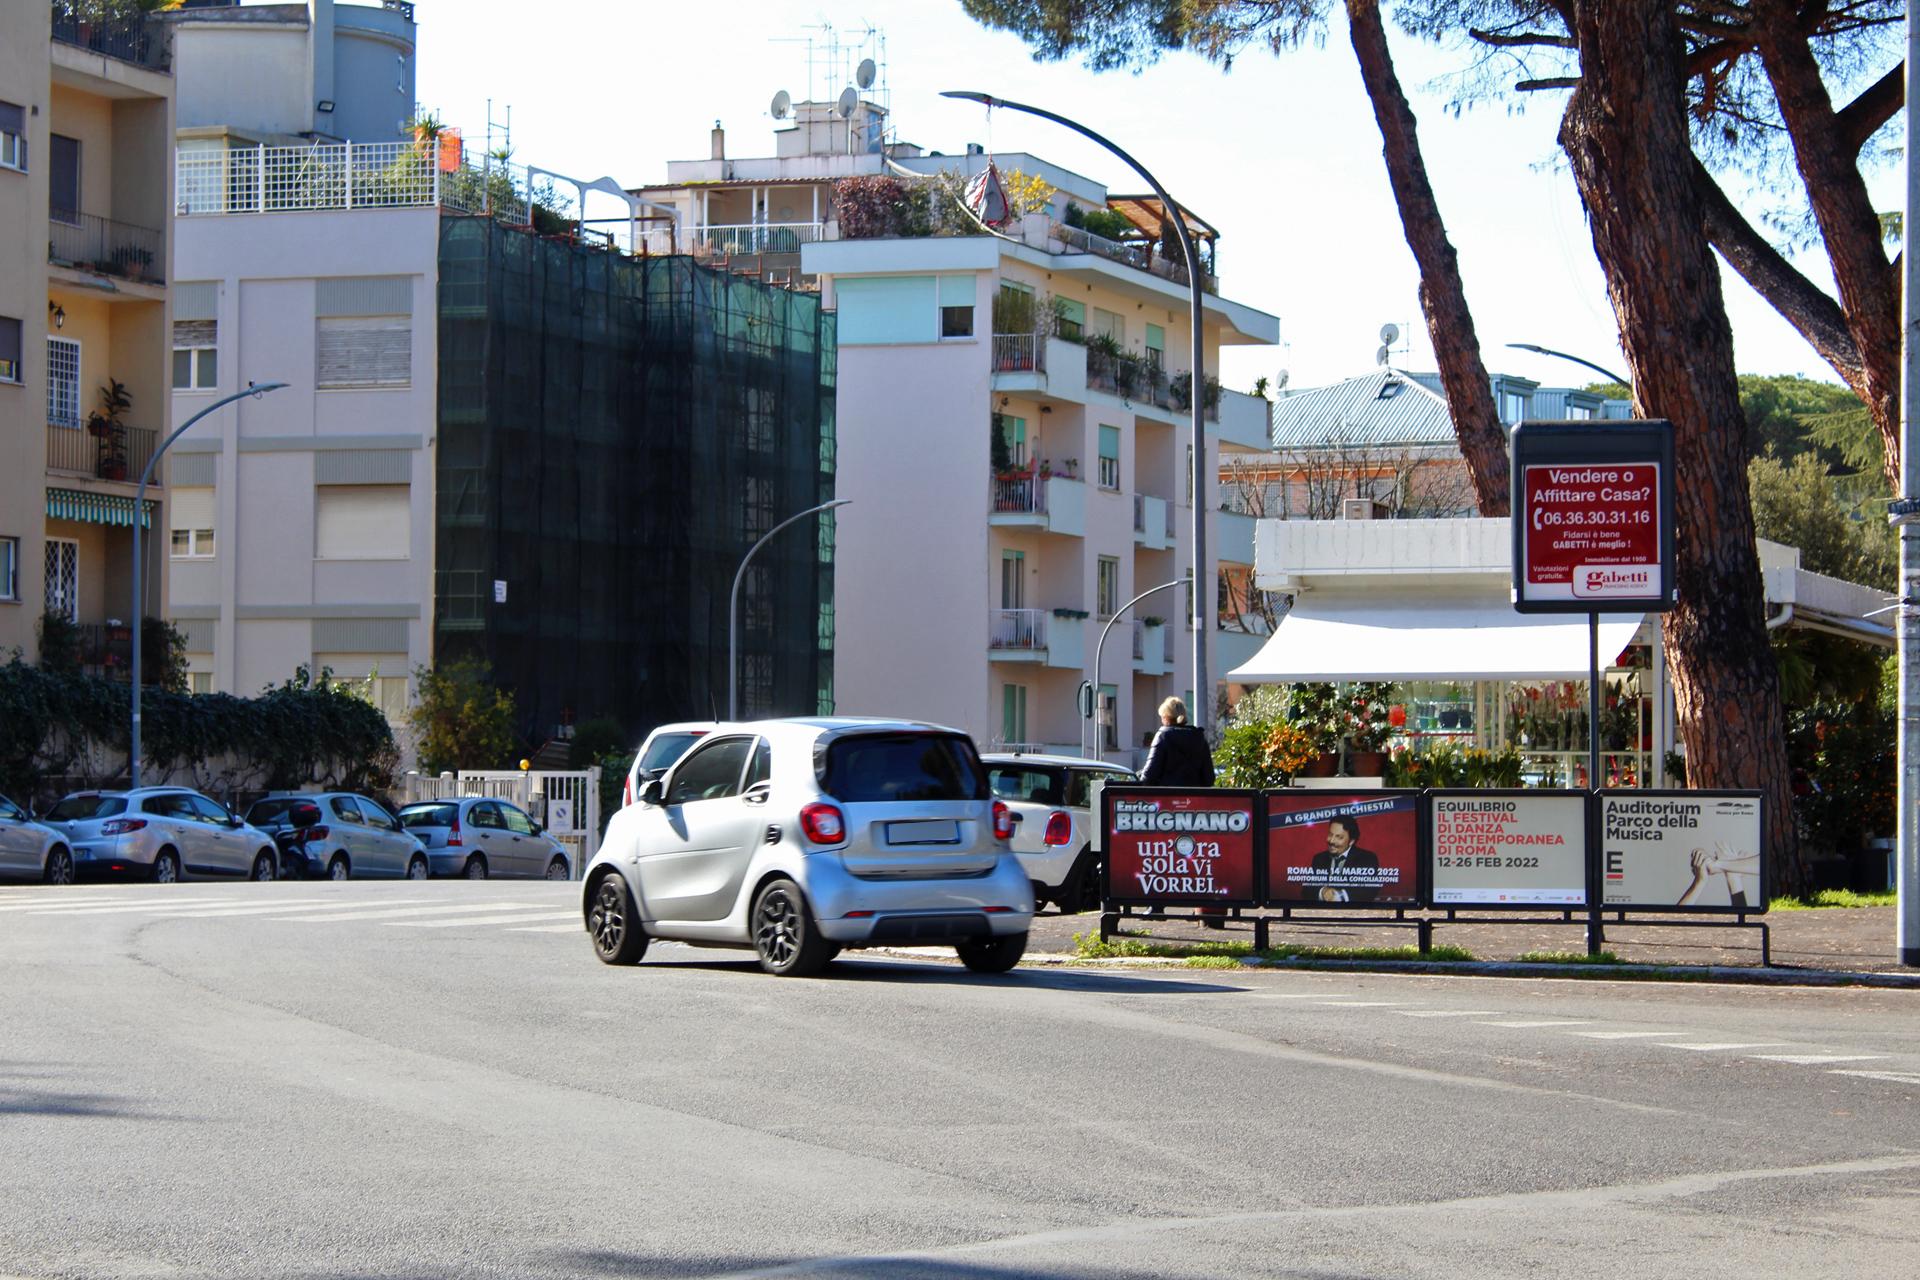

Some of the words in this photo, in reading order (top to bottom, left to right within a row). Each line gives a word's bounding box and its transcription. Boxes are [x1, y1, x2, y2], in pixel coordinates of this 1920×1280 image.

[1549, 470, 1617, 484] Vendere
[1623, 471, 1634, 482] o
[1534, 489, 1596, 503] Affittare
[1601, 487, 1650, 500] Casa?
[1544, 511, 1650, 525] 06.36.30.31.16
[1553, 541, 1589, 549] GABETTI
[1591, 540, 1596, 549] è
[1598, 541, 1626, 549] meglio
[1586, 571, 1647, 590] gabetti
[1116, 801, 1156, 812] Enrico
[1285, 816, 1292, 824] A
[1295, 809, 1337, 822] GRANDE
[1340, 800, 1394, 815] RICHIESTA!
[1438, 802, 1516, 811] EQUILIBRIO
[1607, 801, 1701, 814] Auditorium
[1116, 812, 1249, 831] BRIGNANO
[1438, 813, 1449, 822] IL
[1454, 813, 1518, 822] FESTIVAL
[1607, 815, 1653, 827] Parco
[1658, 815, 1698, 828] della
[1438, 824, 1450, 833] DI
[1456, 824, 1504, 833] DANZA
[1607, 828, 1663, 840] Musica
[1438, 835, 1564, 844] CONTEMPORANEA
[1438, 846, 1450, 855] DI
[1456, 846, 1497, 855] ROMA
[1142, 852, 1189, 874] sola
[1438, 857, 1472, 867] 12-26
[1476, 858, 1502, 867] FEB
[1505, 858, 1539, 867] 2022
[1607, 852, 1623, 873] E
